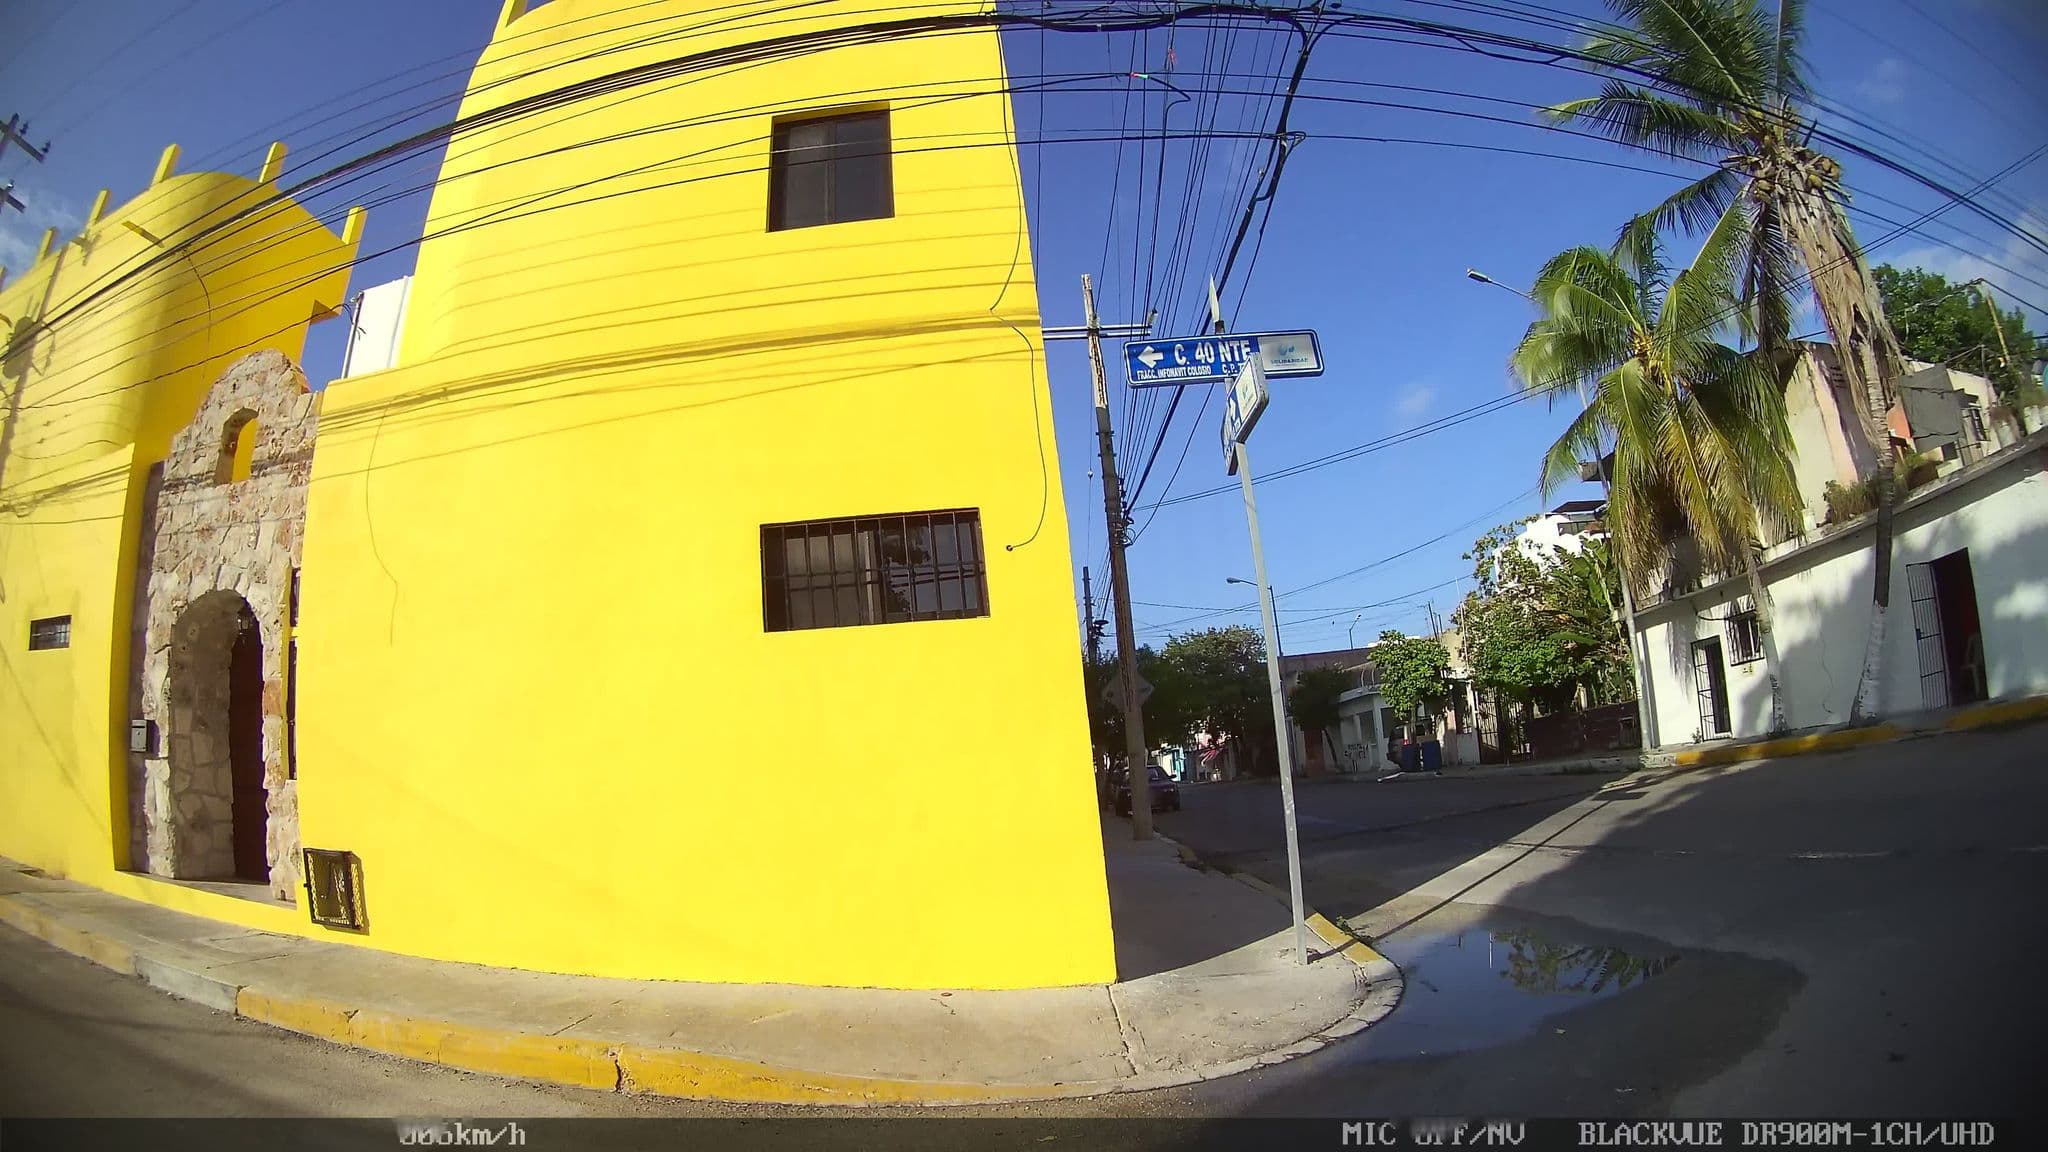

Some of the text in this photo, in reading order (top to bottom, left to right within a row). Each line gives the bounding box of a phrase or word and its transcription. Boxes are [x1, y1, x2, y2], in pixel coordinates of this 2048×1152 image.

[1175, 344, 1190, 365] C.
[1195, 342, 1215, 364] 40
[1136, 369, 1158, 381] FRACC.
[1157, 366, 1187, 379] INFONAVIT
[1187, 364, 1212, 377] COLOSIO
